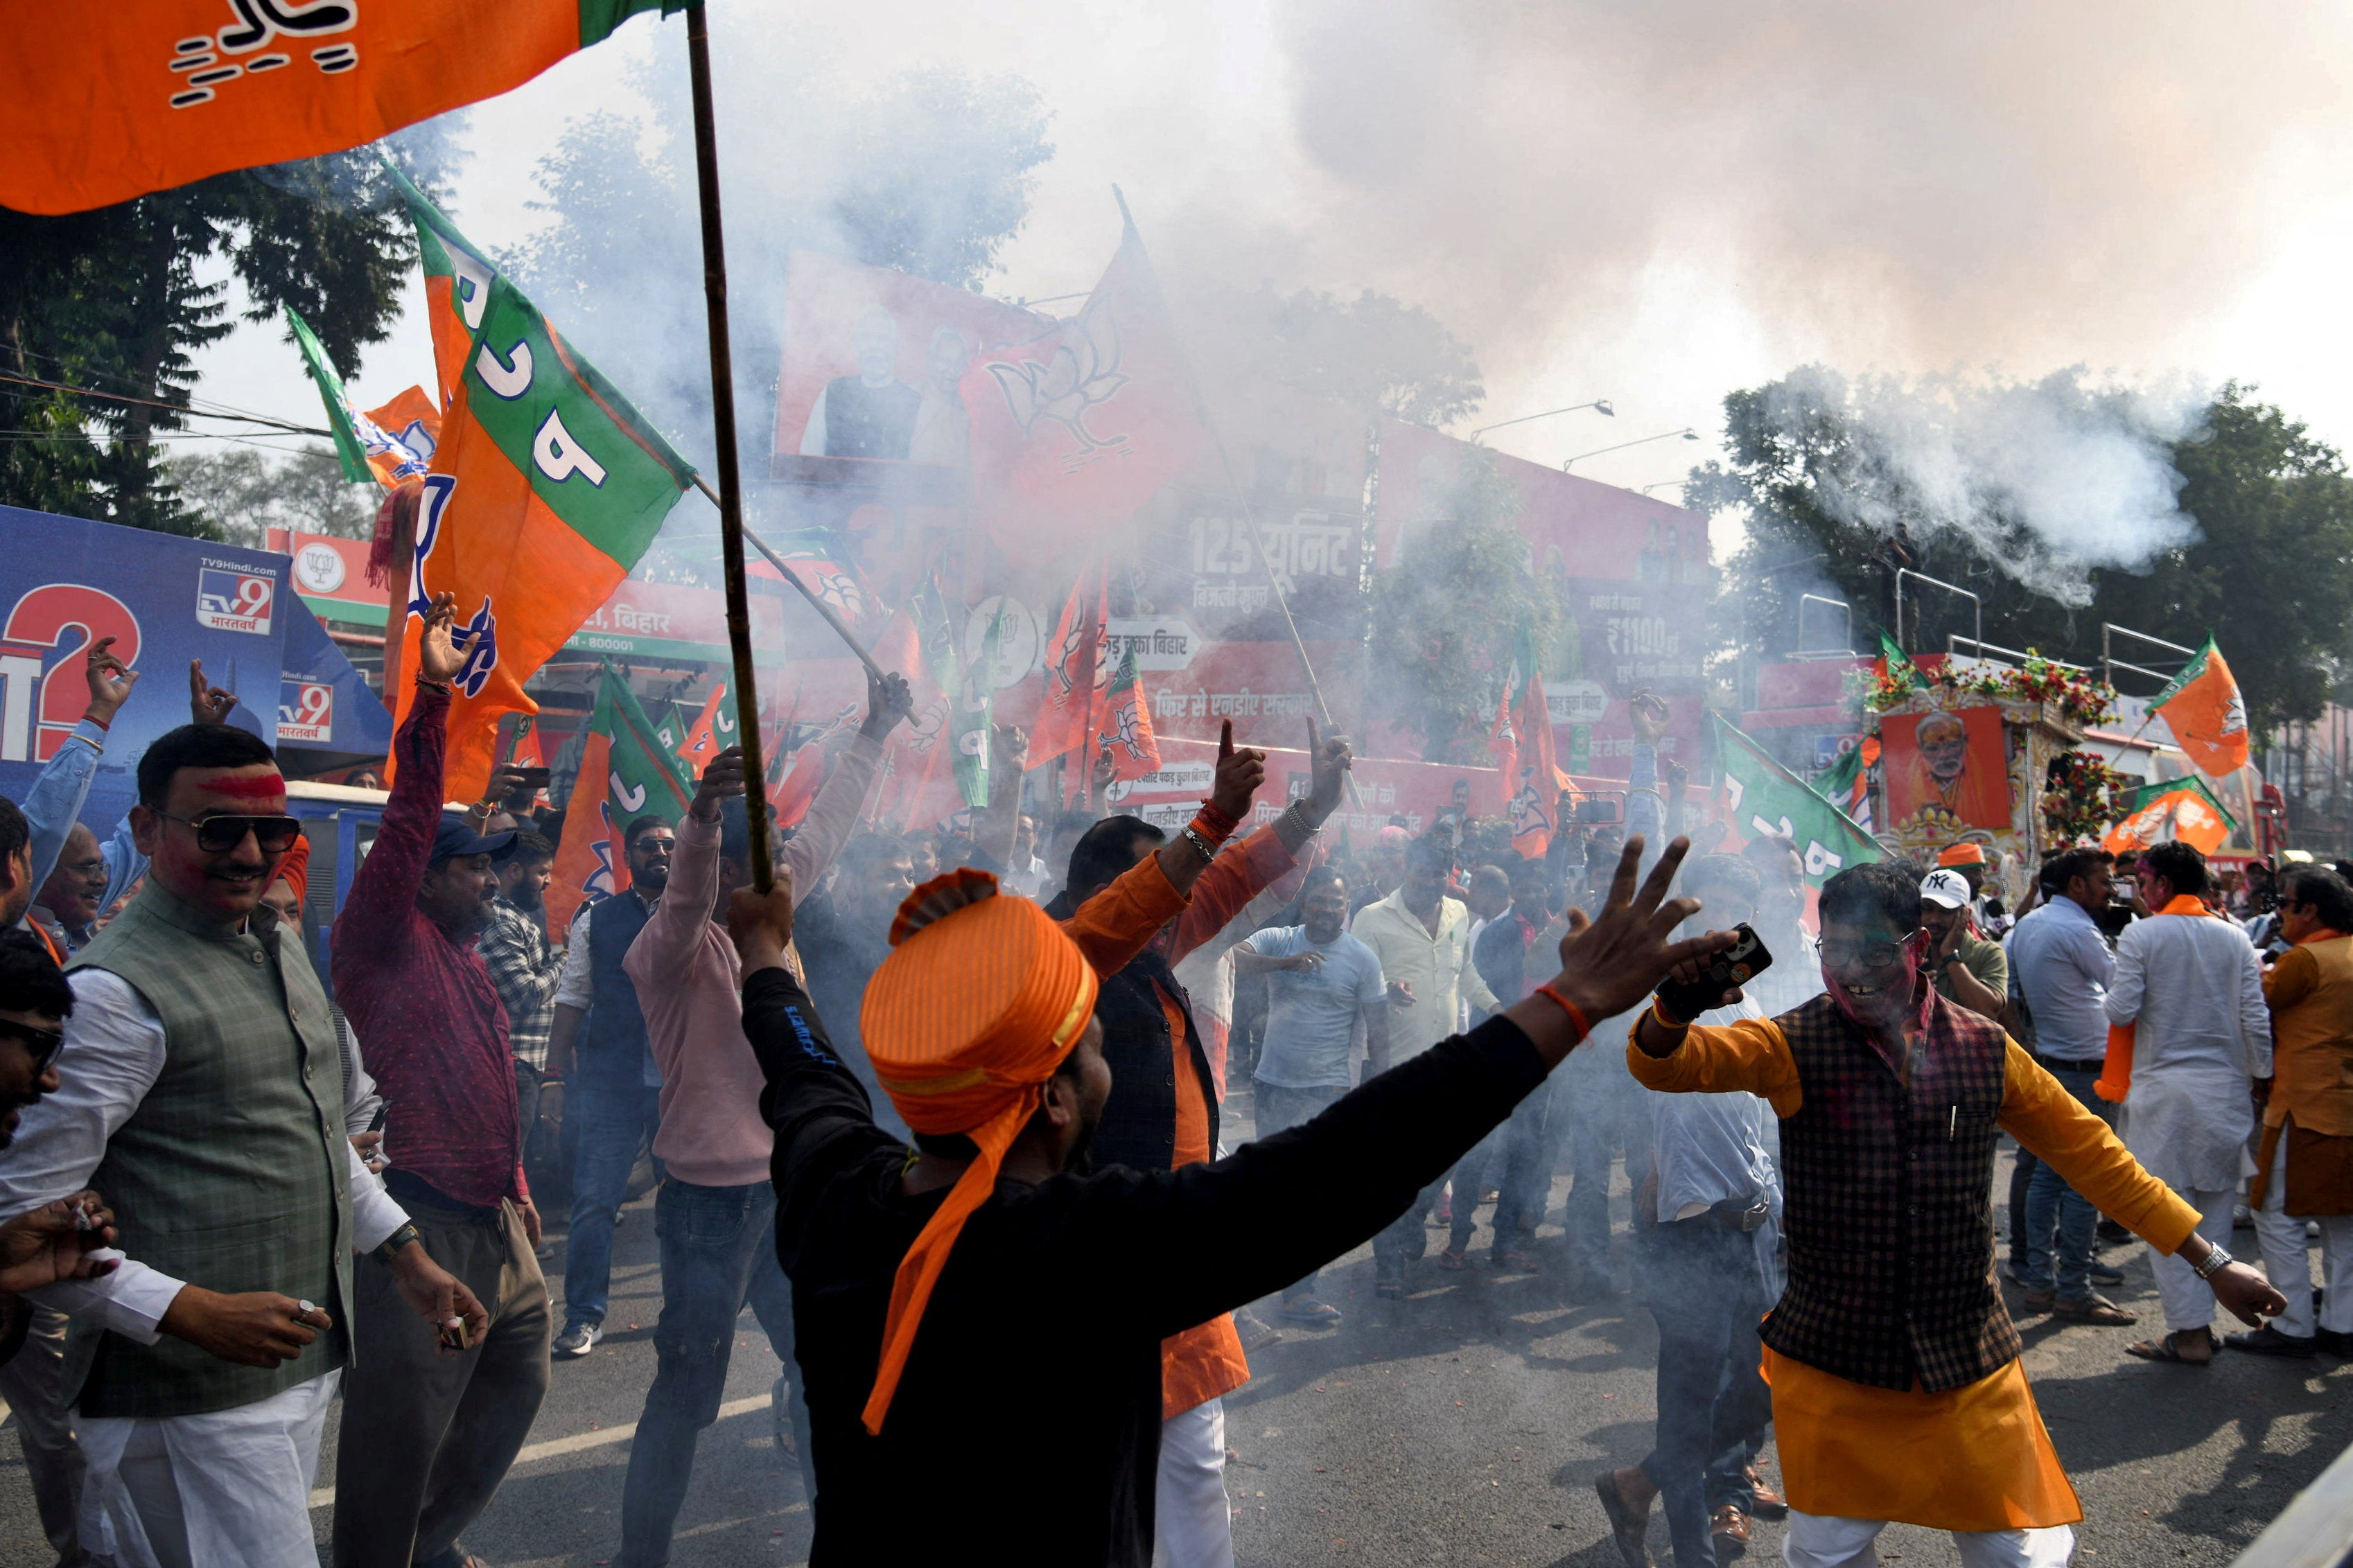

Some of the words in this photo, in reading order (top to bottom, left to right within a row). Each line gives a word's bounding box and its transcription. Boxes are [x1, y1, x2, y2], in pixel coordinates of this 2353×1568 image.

[1189, 517, 1252, 574] 125
[1261, 512, 1352, 594] यूनिट
[201, 557, 277, 577] TV9Hindi.com
[201, 579, 271, 617] TV9
[211, 616, 259, 631] भारतवर्ष
[613, 604, 672, 634] बिहार
[589, 637, 634, 652] 800001
[1154, 628, 1188, 655] बिहार
[281, 670, 317, 682] Hindi.com
[1155, 688, 1189, 719] फिर
[1190, 687, 1207, 717] से
[1210, 687, 1261, 716] एनडीए
[1262, 693, 1314, 716] सरकार
[1159, 771, 1175, 786] पकड़
[1176, 770, 1191, 787] चुका
[1191, 768, 1211, 783] बिहार
[1146, 805, 1180, 827] एनडीए
[1927, 873, 1949, 890] NY
